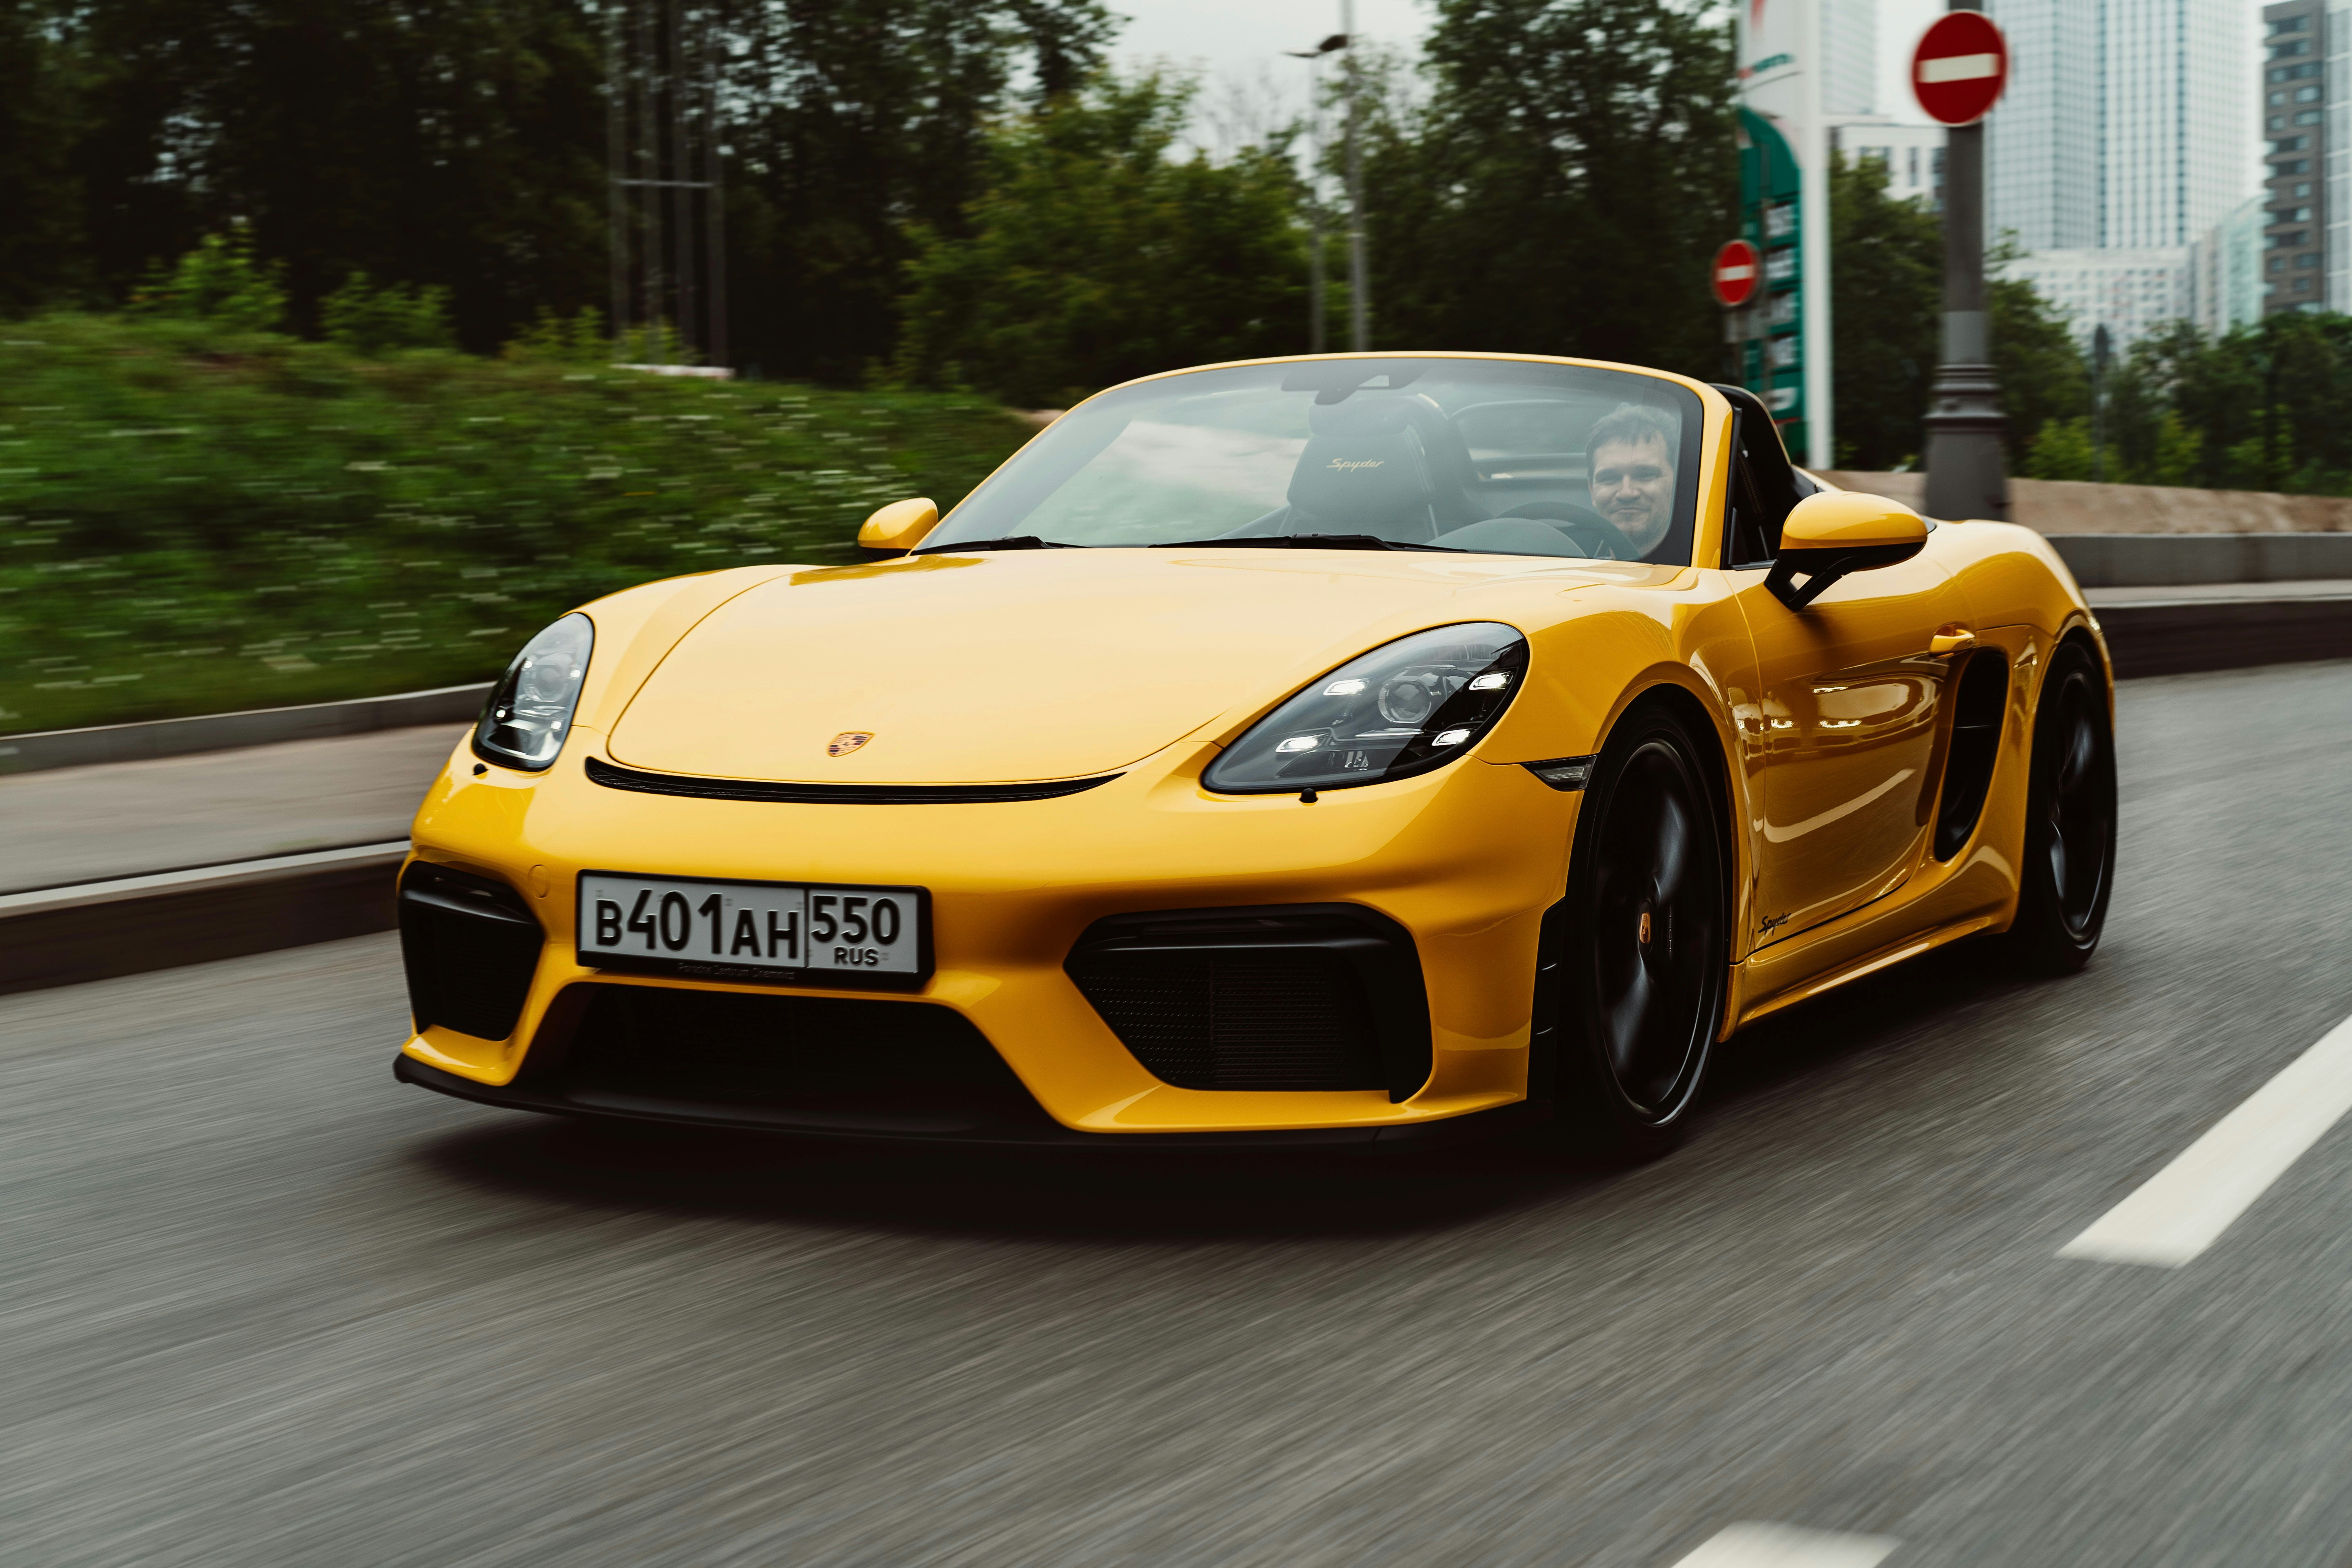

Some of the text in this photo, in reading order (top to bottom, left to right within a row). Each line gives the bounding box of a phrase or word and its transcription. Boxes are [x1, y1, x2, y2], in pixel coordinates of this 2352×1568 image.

[1326, 458, 1385, 473] Spyder
[810, 894, 900, 945] 550
[1757, 912, 1792, 937] Spyder
[833, 946, 880, 966] RUS
